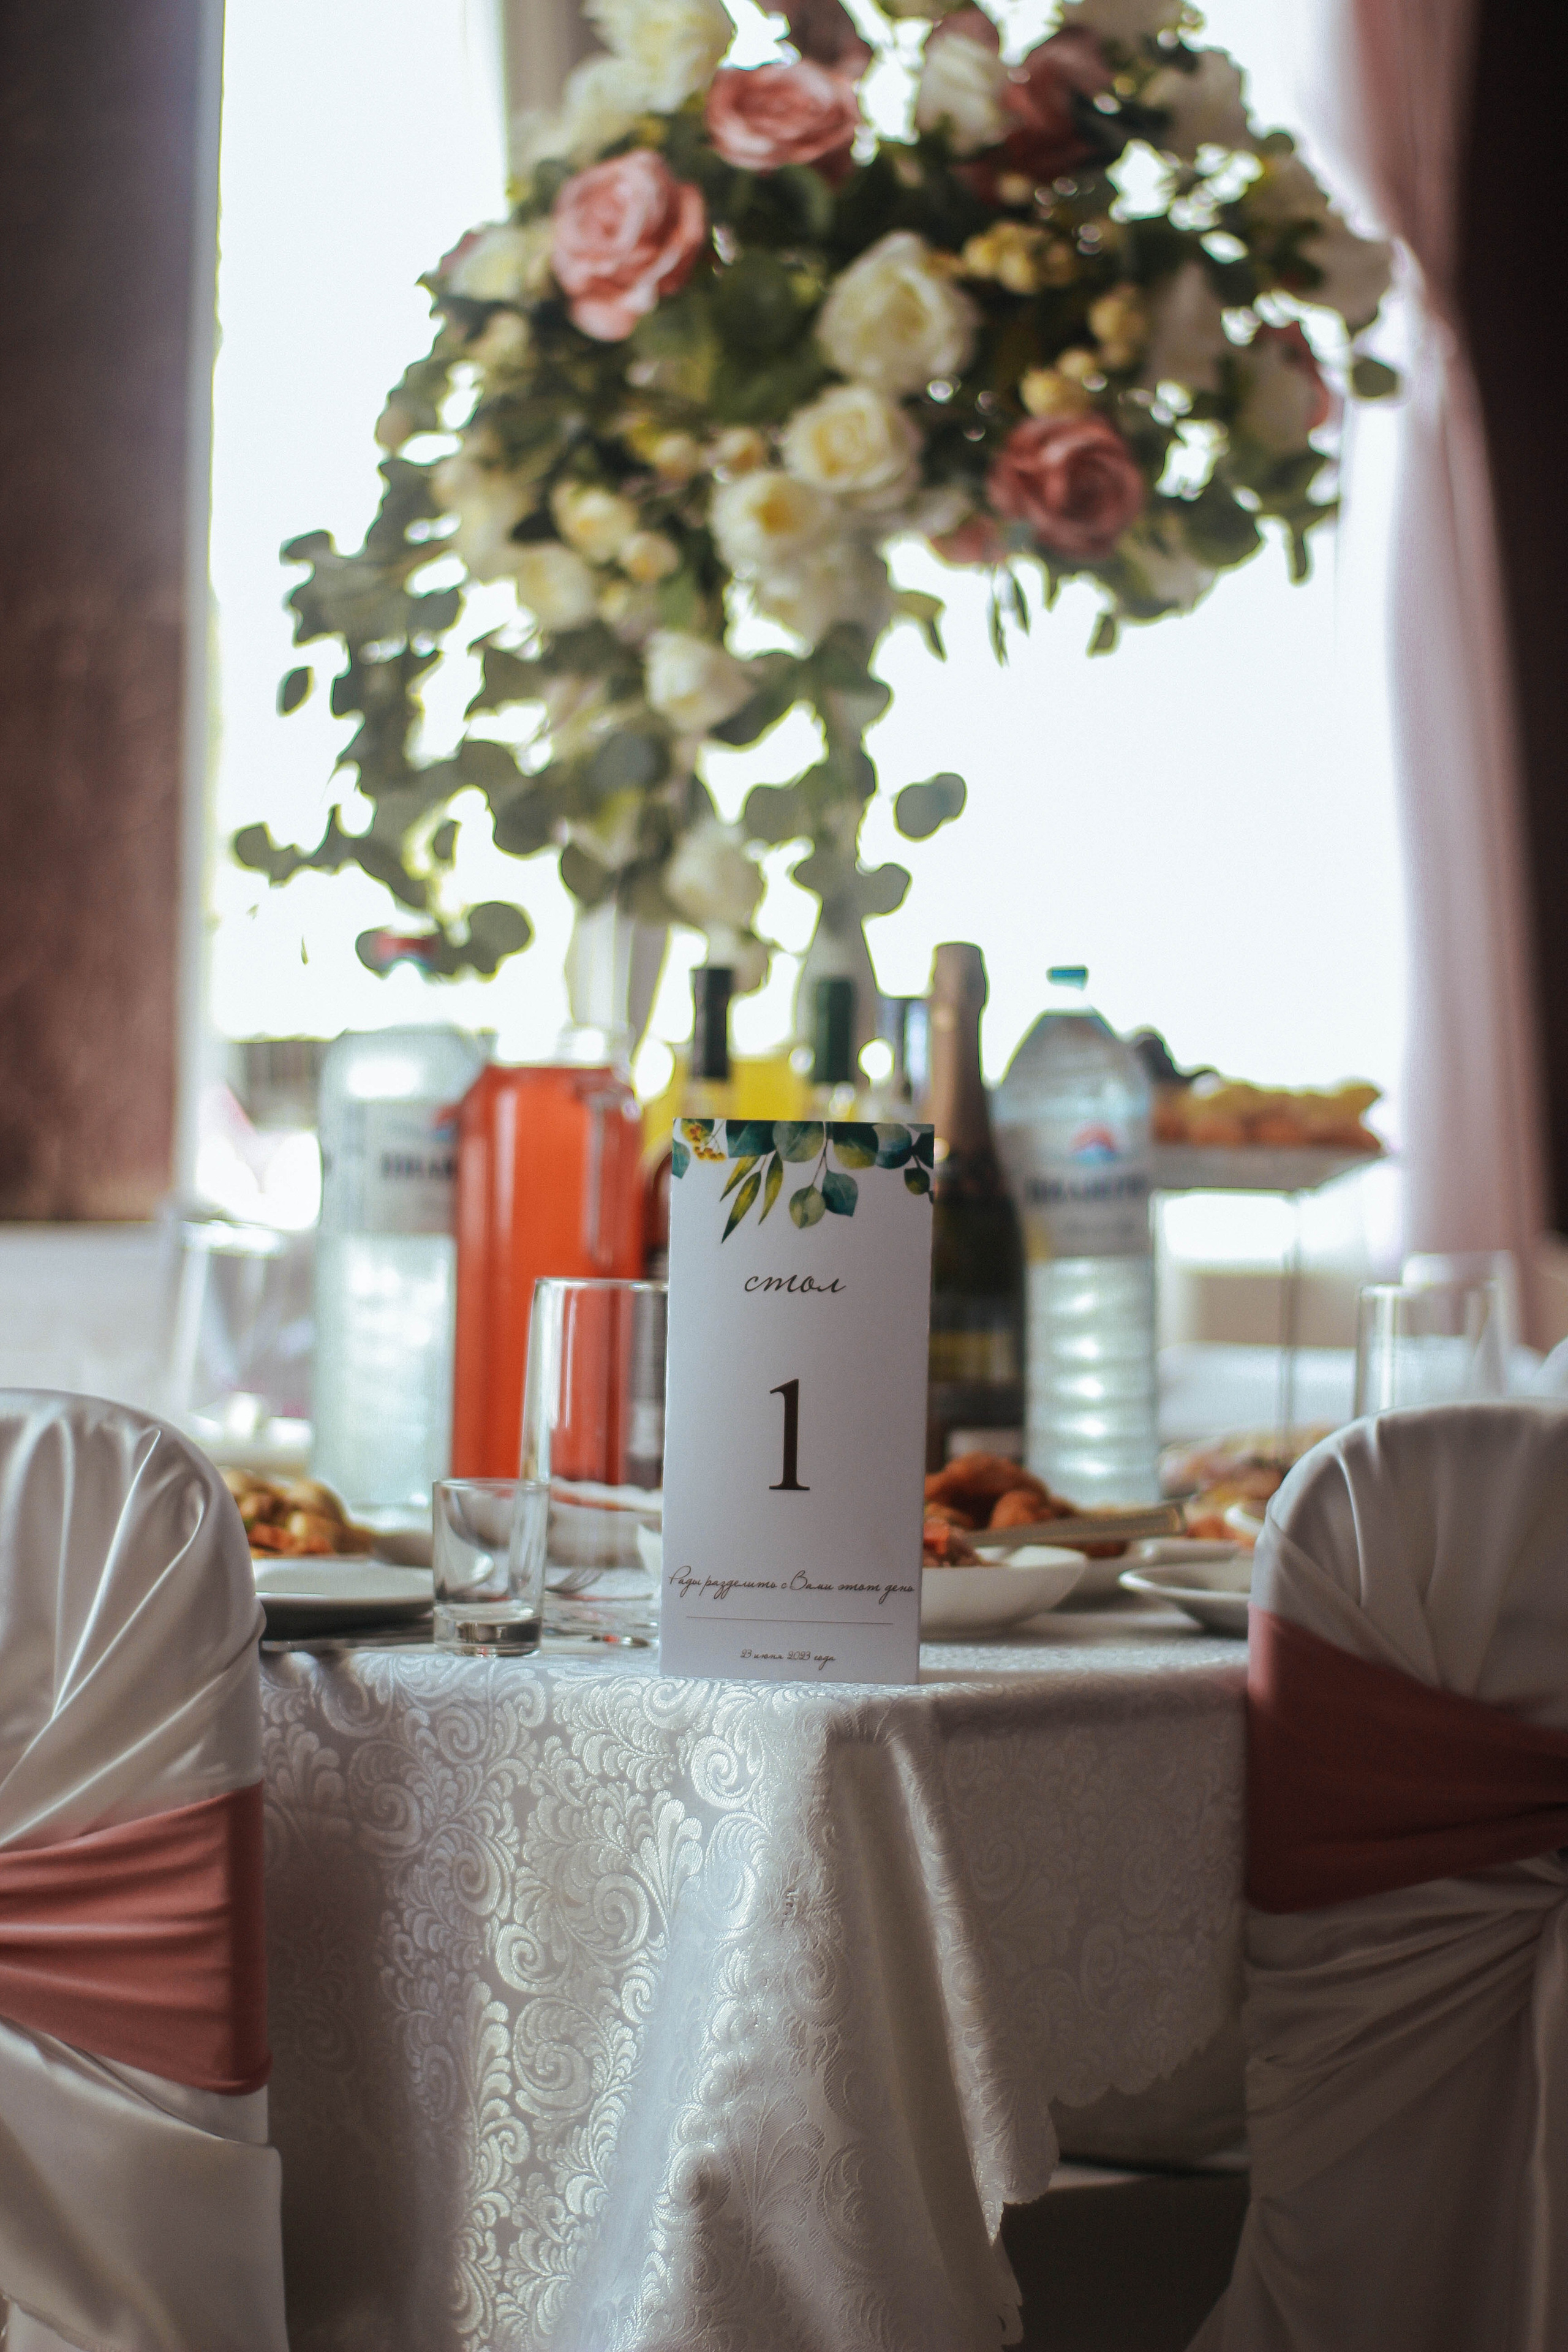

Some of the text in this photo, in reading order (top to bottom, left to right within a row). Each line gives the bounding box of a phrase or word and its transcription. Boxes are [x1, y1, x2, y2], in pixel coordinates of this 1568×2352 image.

[744, 1274, 847, 1294] стол
[769, 1379, 810, 1491] 1
[668, 1566, 701, 1597] Рады
[699, 1575, 778, 1599] разделить
[790, 1570, 834, 1590] Вами
[837, 1582, 881, 1592] этот
[878, 1583, 915, 1605] день
[741, 1649, 753, 1658] 23
[786, 1650, 812, 1660] 2023
[813, 1655, 837, 1671] года
